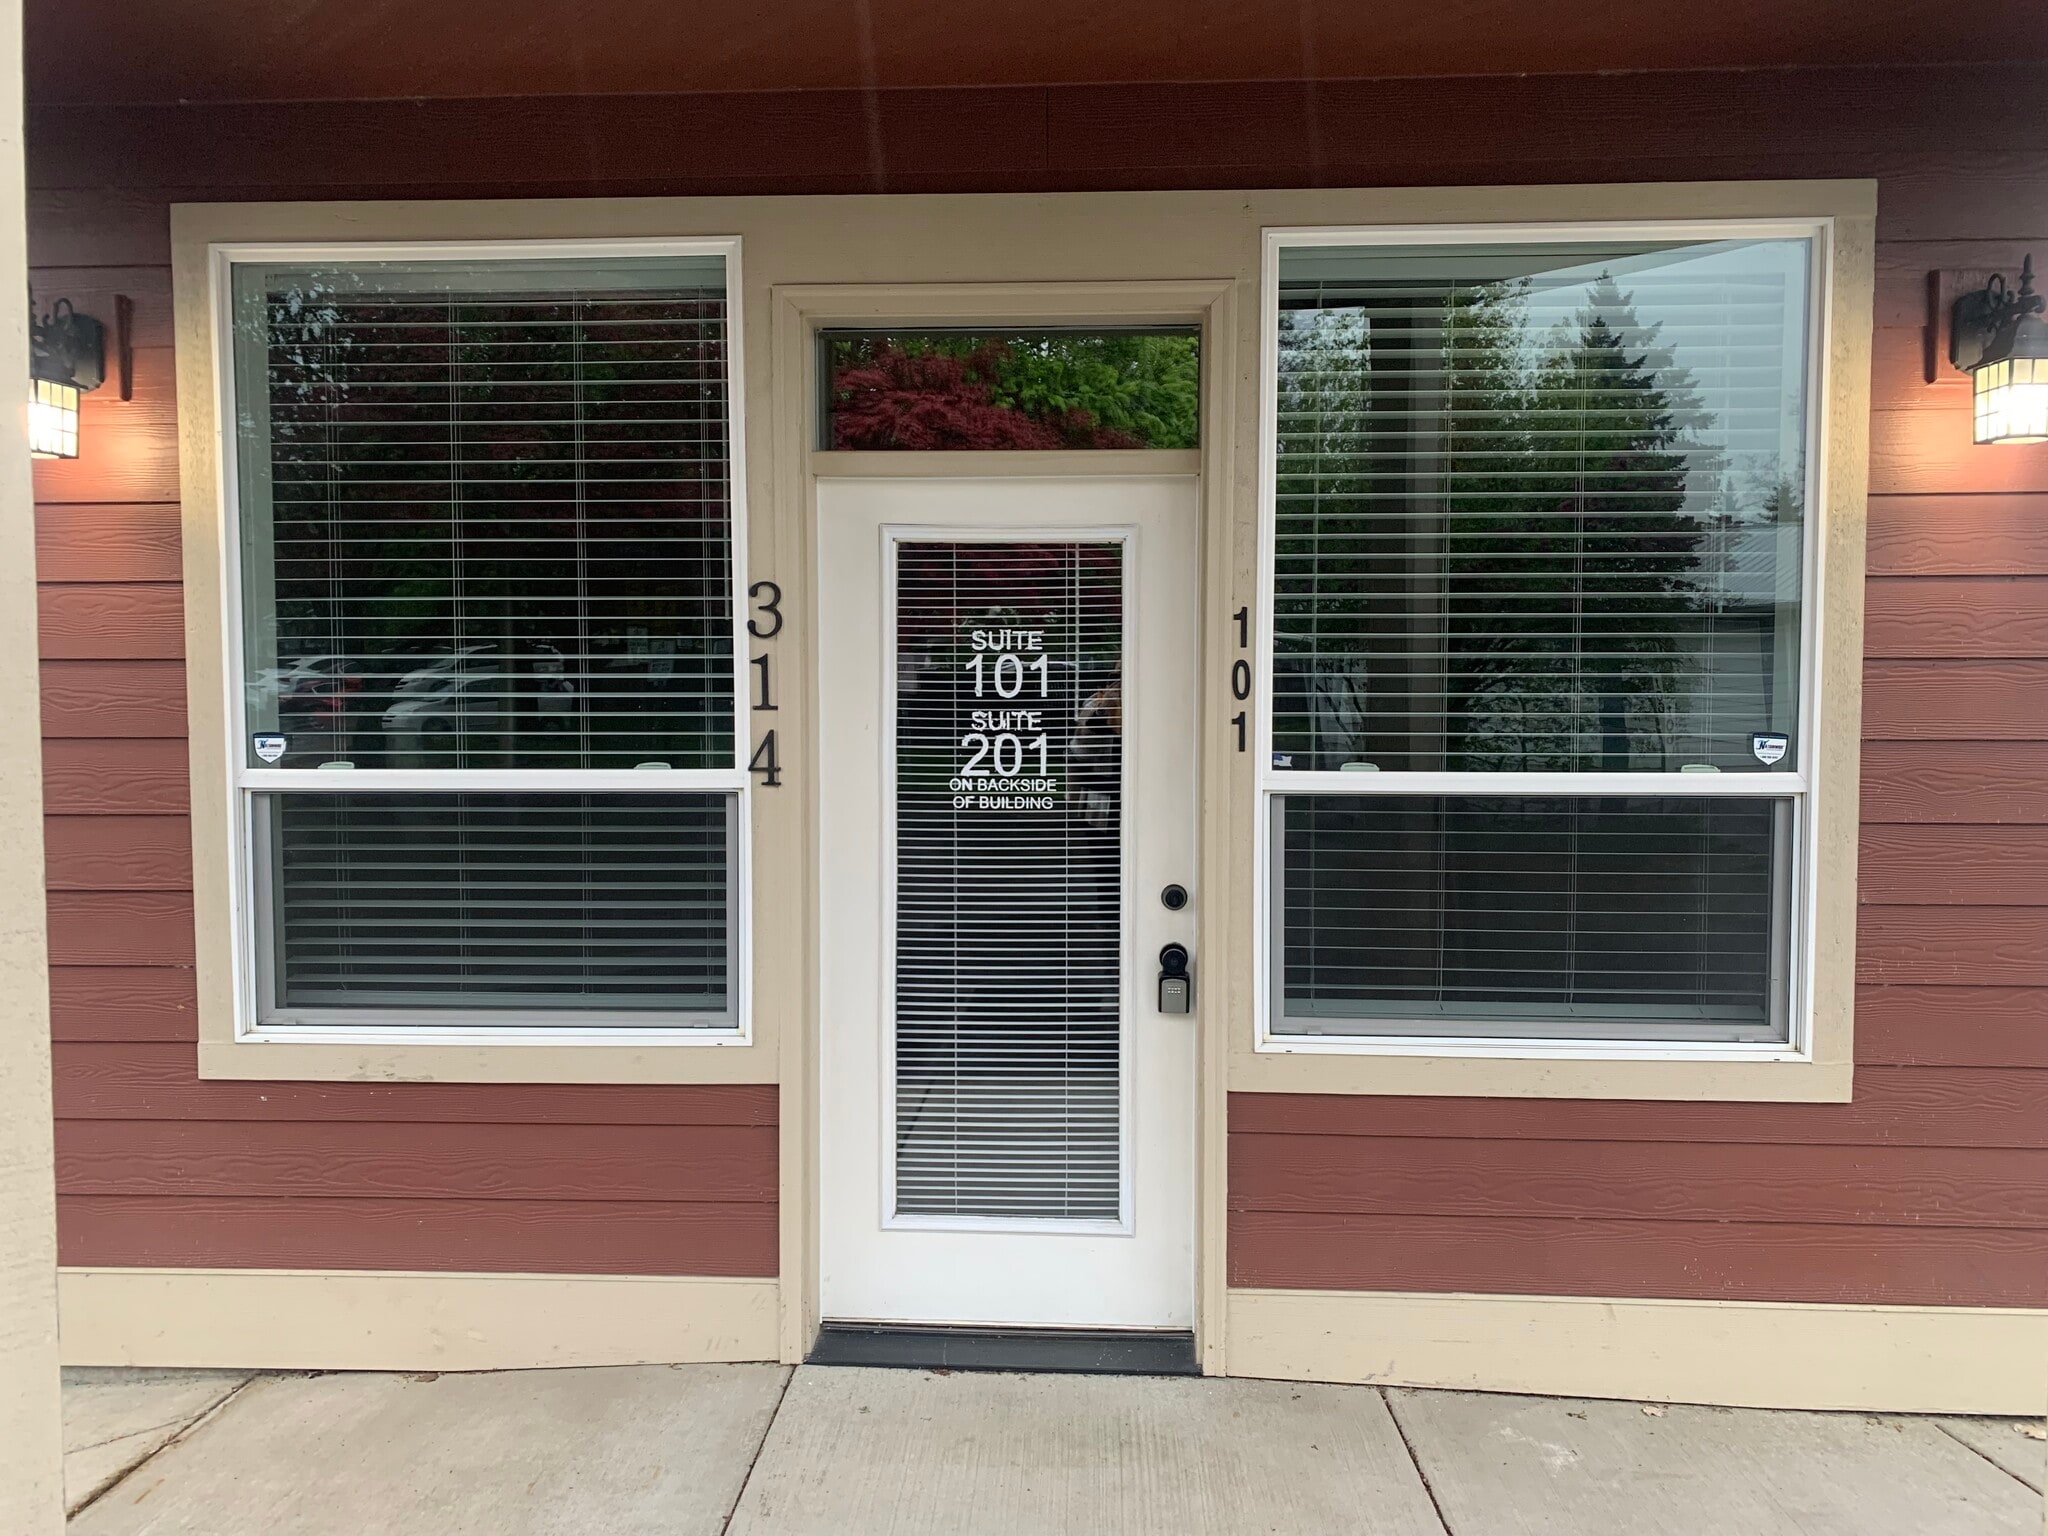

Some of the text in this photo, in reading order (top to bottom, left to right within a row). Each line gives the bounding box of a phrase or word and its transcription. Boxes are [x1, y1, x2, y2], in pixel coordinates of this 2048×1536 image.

[971, 629, 1044, 650] SUITE
[747, 581, 782, 786] 314
[965, 653, 1048, 698] 101
[1232, 606, 1250, 752] 101
[971, 711, 1042, 731] SUITE
[960, 732, 1047, 777] 201
[950, 778, 1057, 792] ON BACKSIDE
[953, 796, 1053, 809] OF BUILDING
